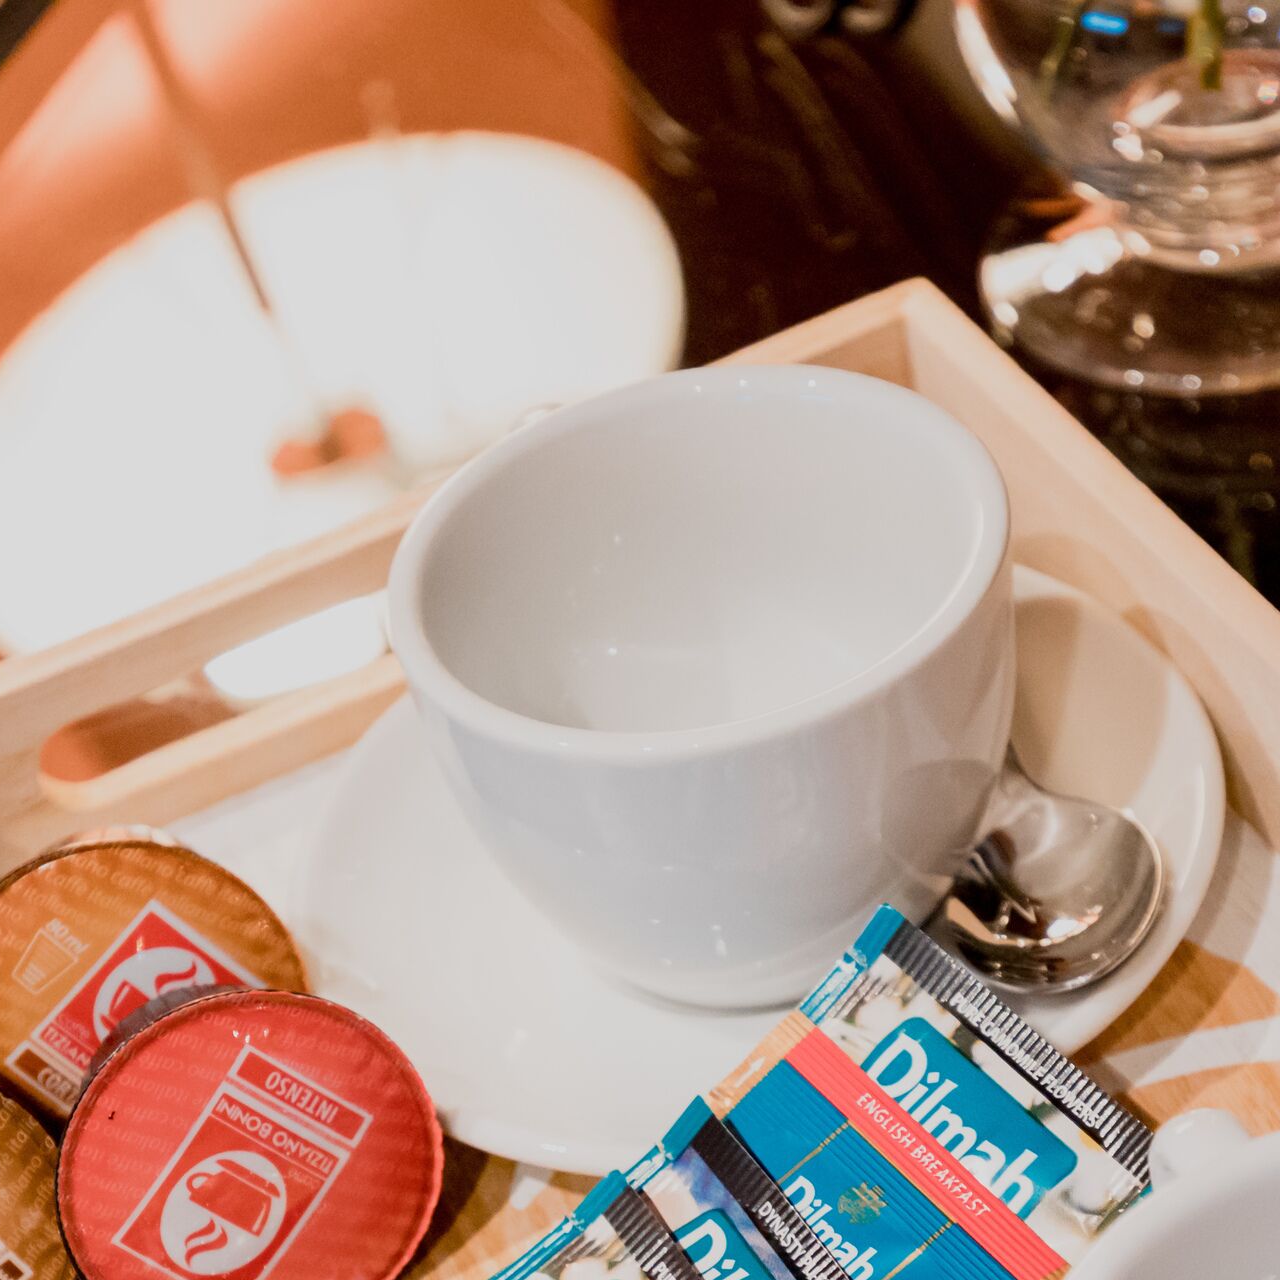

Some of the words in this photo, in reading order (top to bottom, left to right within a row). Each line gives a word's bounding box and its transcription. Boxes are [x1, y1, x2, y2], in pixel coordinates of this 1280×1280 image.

[43, 1025, 93, 1071] TIZIAN
[948, 991, 987, 1028] PURE
[976, 1016, 1048, 1083] CAMOMILE
[1038, 1070, 1103, 1131] FLOWERS
[214, 1098, 274, 1142] BONINI
[264, 1070, 340, 1125] INTENSO
[866, 1030, 1038, 1218] Dilmah
[272, 1130, 335, 1176] TIZIANO
[855, 1092, 917, 1149] ENGLISH
[910, 1135, 992, 1219] BREAKFAST
[752, 1200, 809, 1263] DYNASTY
